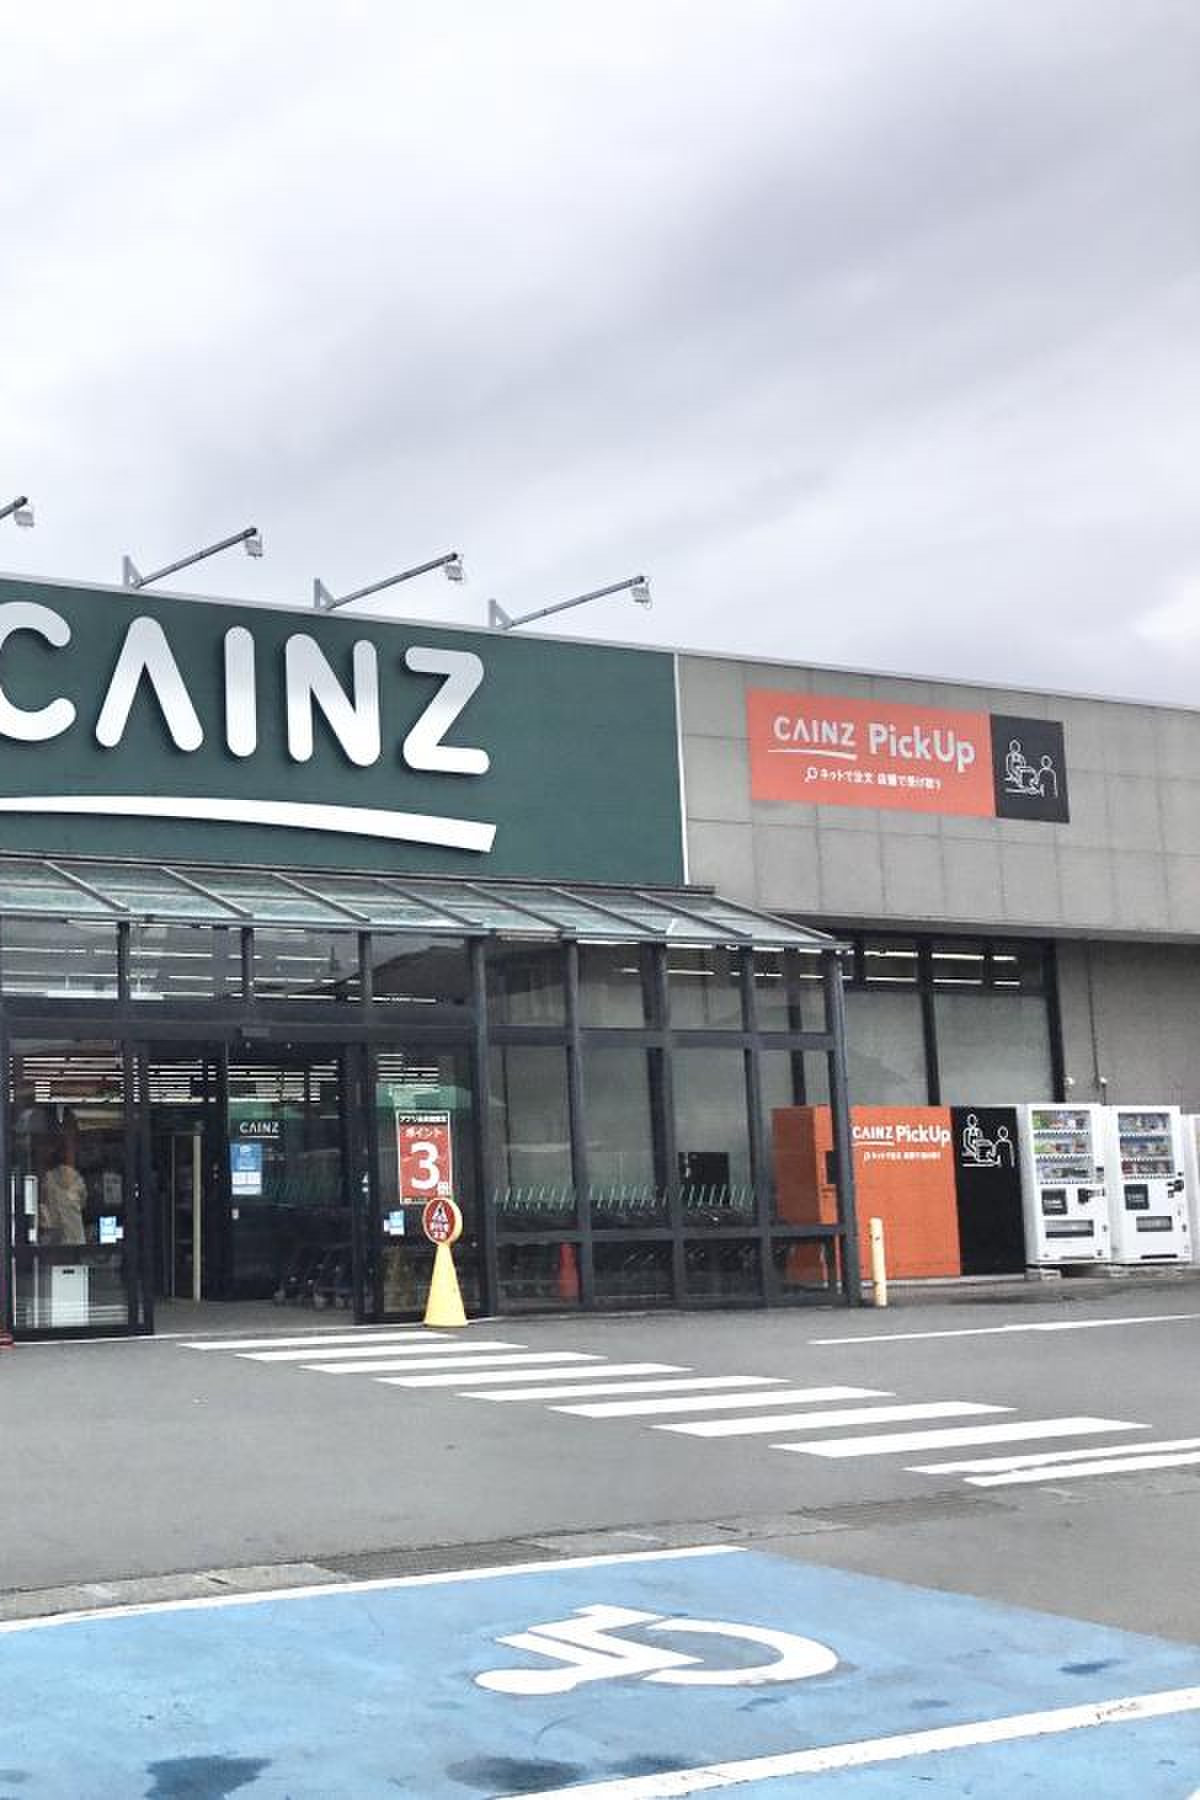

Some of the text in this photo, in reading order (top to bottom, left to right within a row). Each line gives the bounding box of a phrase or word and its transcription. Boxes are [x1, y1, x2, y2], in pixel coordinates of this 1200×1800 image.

[773, 715, 976, 773] CAINZ PickUp
[240, 1121, 280, 1134] CAINZ
[852, 1124, 951, 1148] CAINZ PickUp
[411, 1141, 440, 1190] 3
